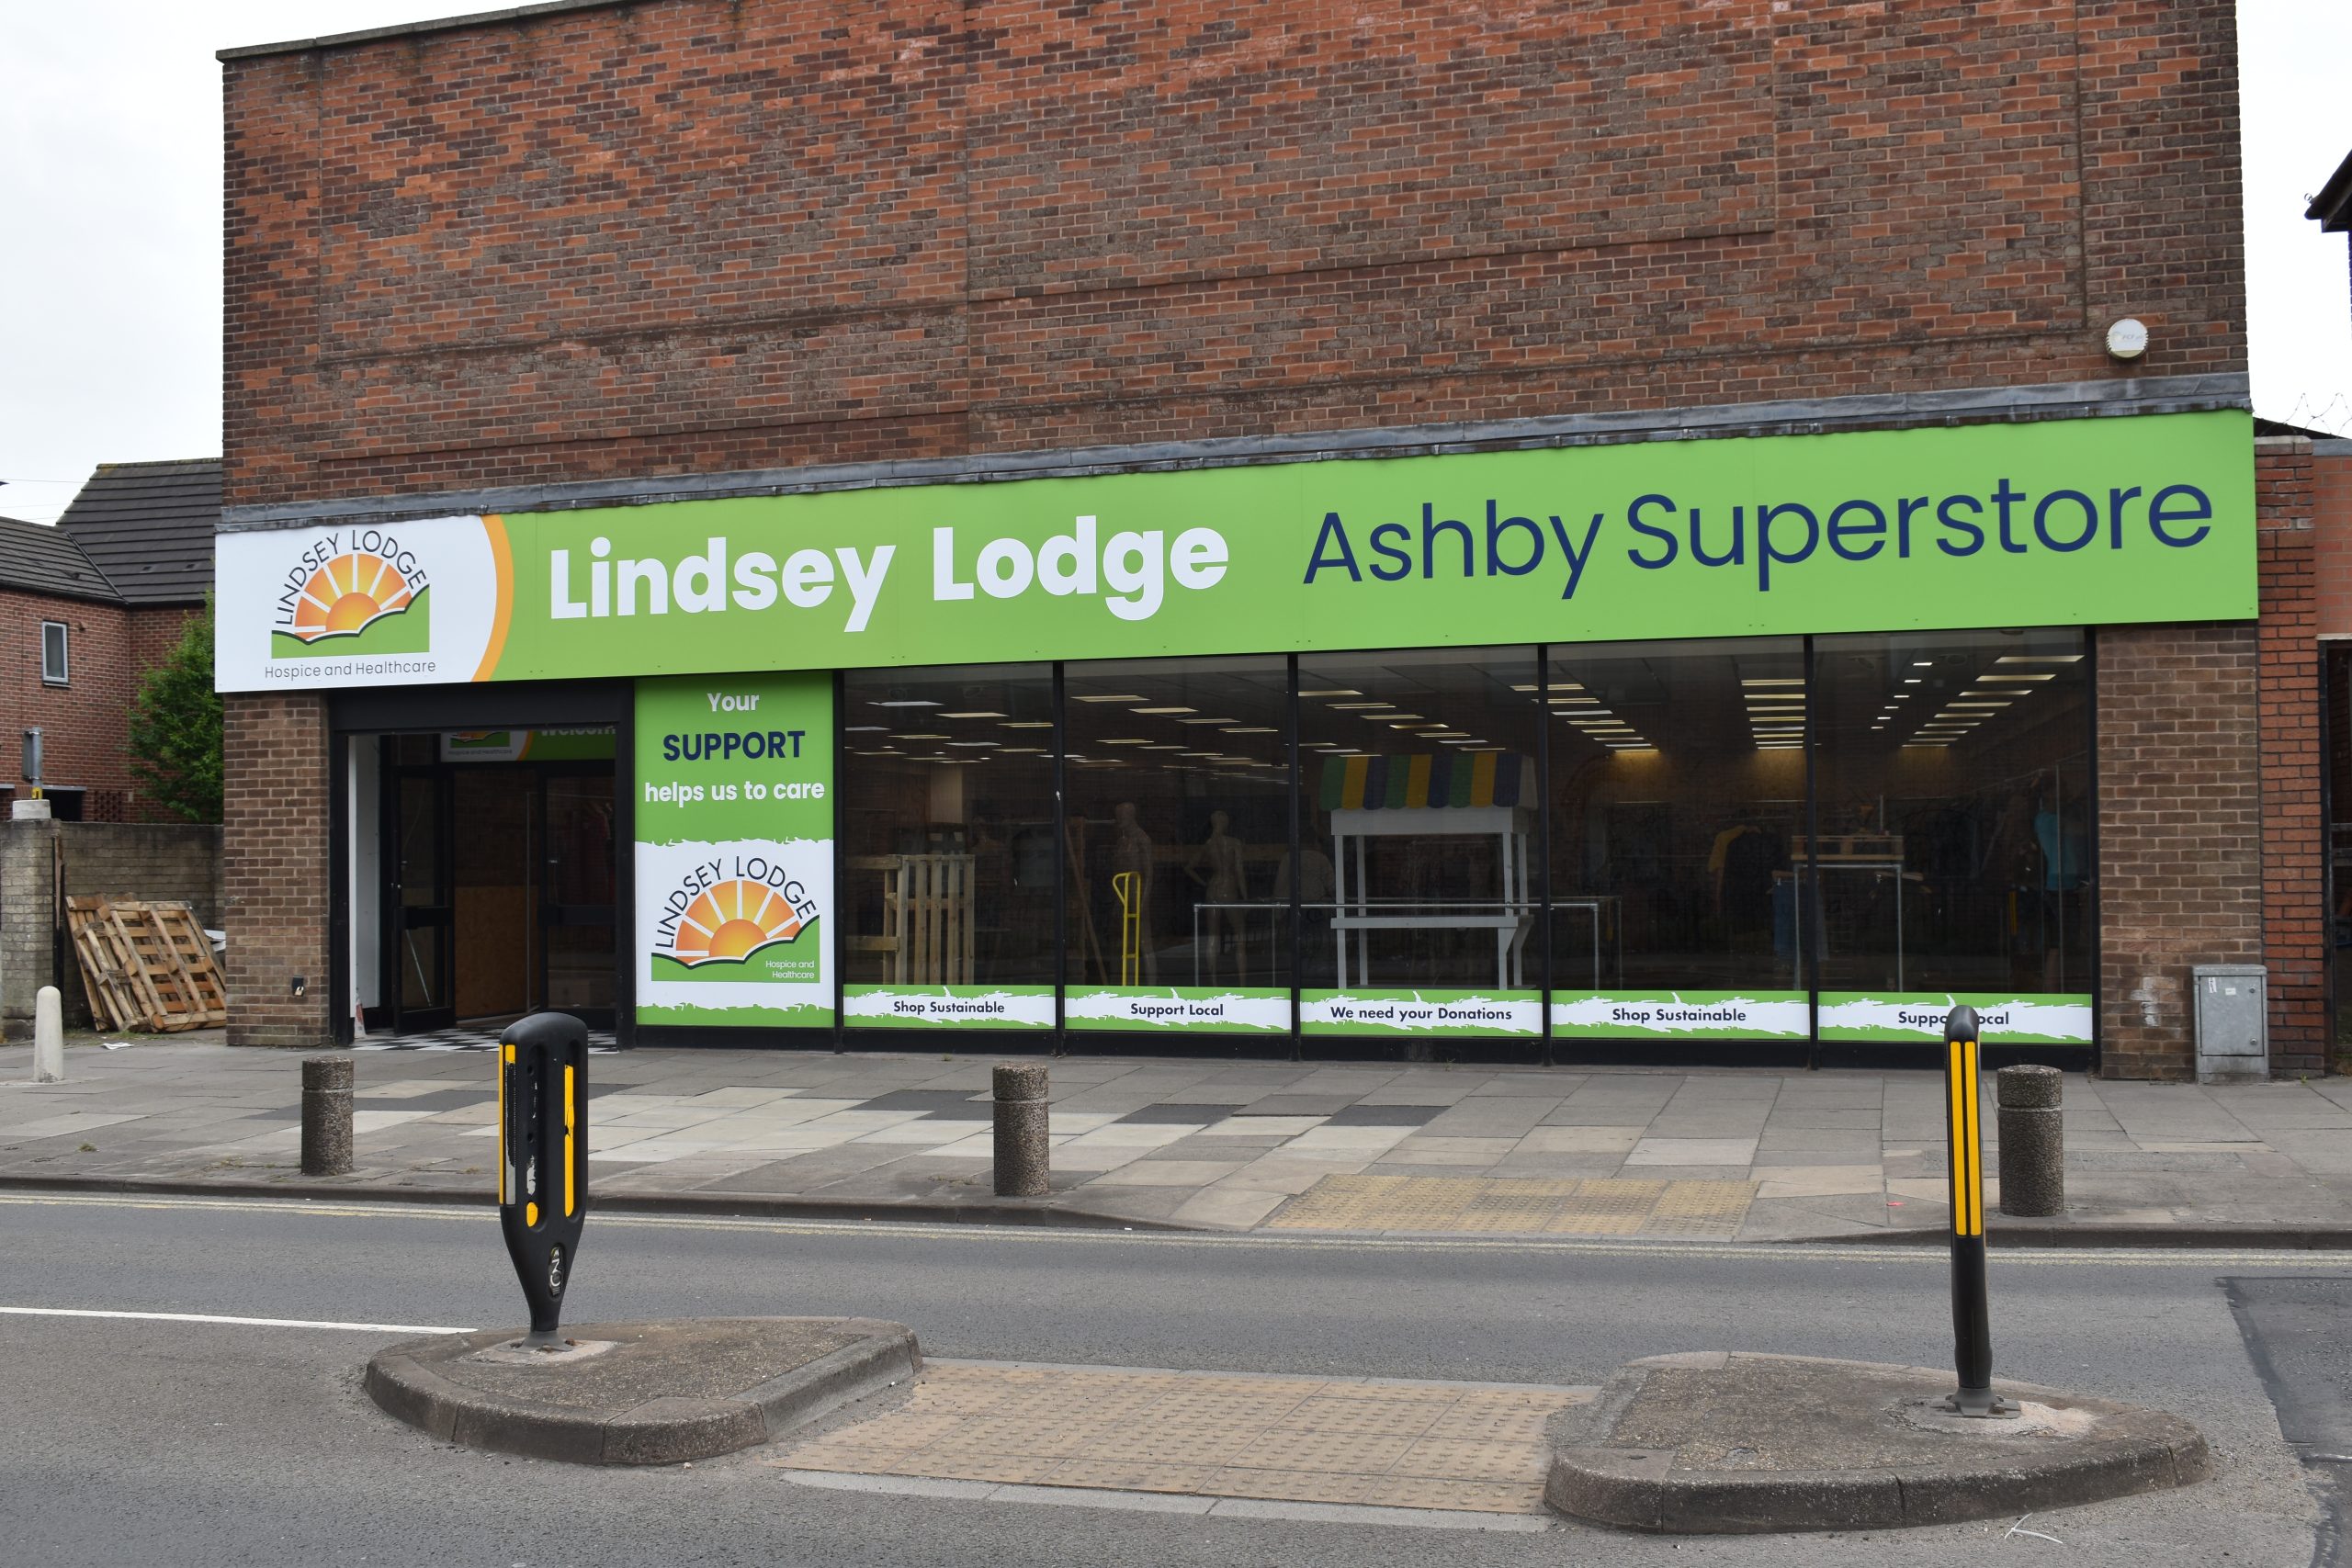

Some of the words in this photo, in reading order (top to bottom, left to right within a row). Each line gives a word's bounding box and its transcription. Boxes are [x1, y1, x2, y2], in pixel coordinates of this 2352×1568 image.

[1303, 499, 1605, 600] Ashby
[1627, 478, 2212, 592] Superstore
[276, 533, 339, 626] LINDSEY
[352, 530, 426, 590] LODGE
[551, 536, 896, 632] Lindsey
[933, 515, 1229, 621] Lodge
[265, 664, 322, 681] Hospice
[324, 662, 352, 676] and
[356, 660, 436, 675] Healthcare
[707, 693, 760, 712] Your
[663, 730, 806, 761] SUPPORT
[645, 782, 705, 808] helps
[711, 784, 738, 801] us
[744, 781, 767, 800] to
[773, 782, 825, 800] care
[655, 858, 722, 949] LINDSEY
[736, 855, 817, 919] LODGE
[765, 960, 797, 970] Hospice
[798, 960, 815, 968] and
[772, 970, 815, 979] Healthcare
[893, 1000, 925, 1016] Shop
[930, 1000, 1005, 1013] Sustainable
[1130, 1003, 1185, 1018] Support
[1189, 1003, 1224, 1016] Local
[1330, 1006, 1354, 1018] We
[1359, 1006, 1394, 1019] need
[1398, 1010, 1433, 1022] your
[1438, 1007, 1512, 1020] Donations
[1612, 1008, 1651, 1023] Shop
[1657, 1008, 1747, 1021] Sustainable
[1898, 1011, 1947, 1028] Suppo
[1978, 1011, 2009, 1025] ocal
